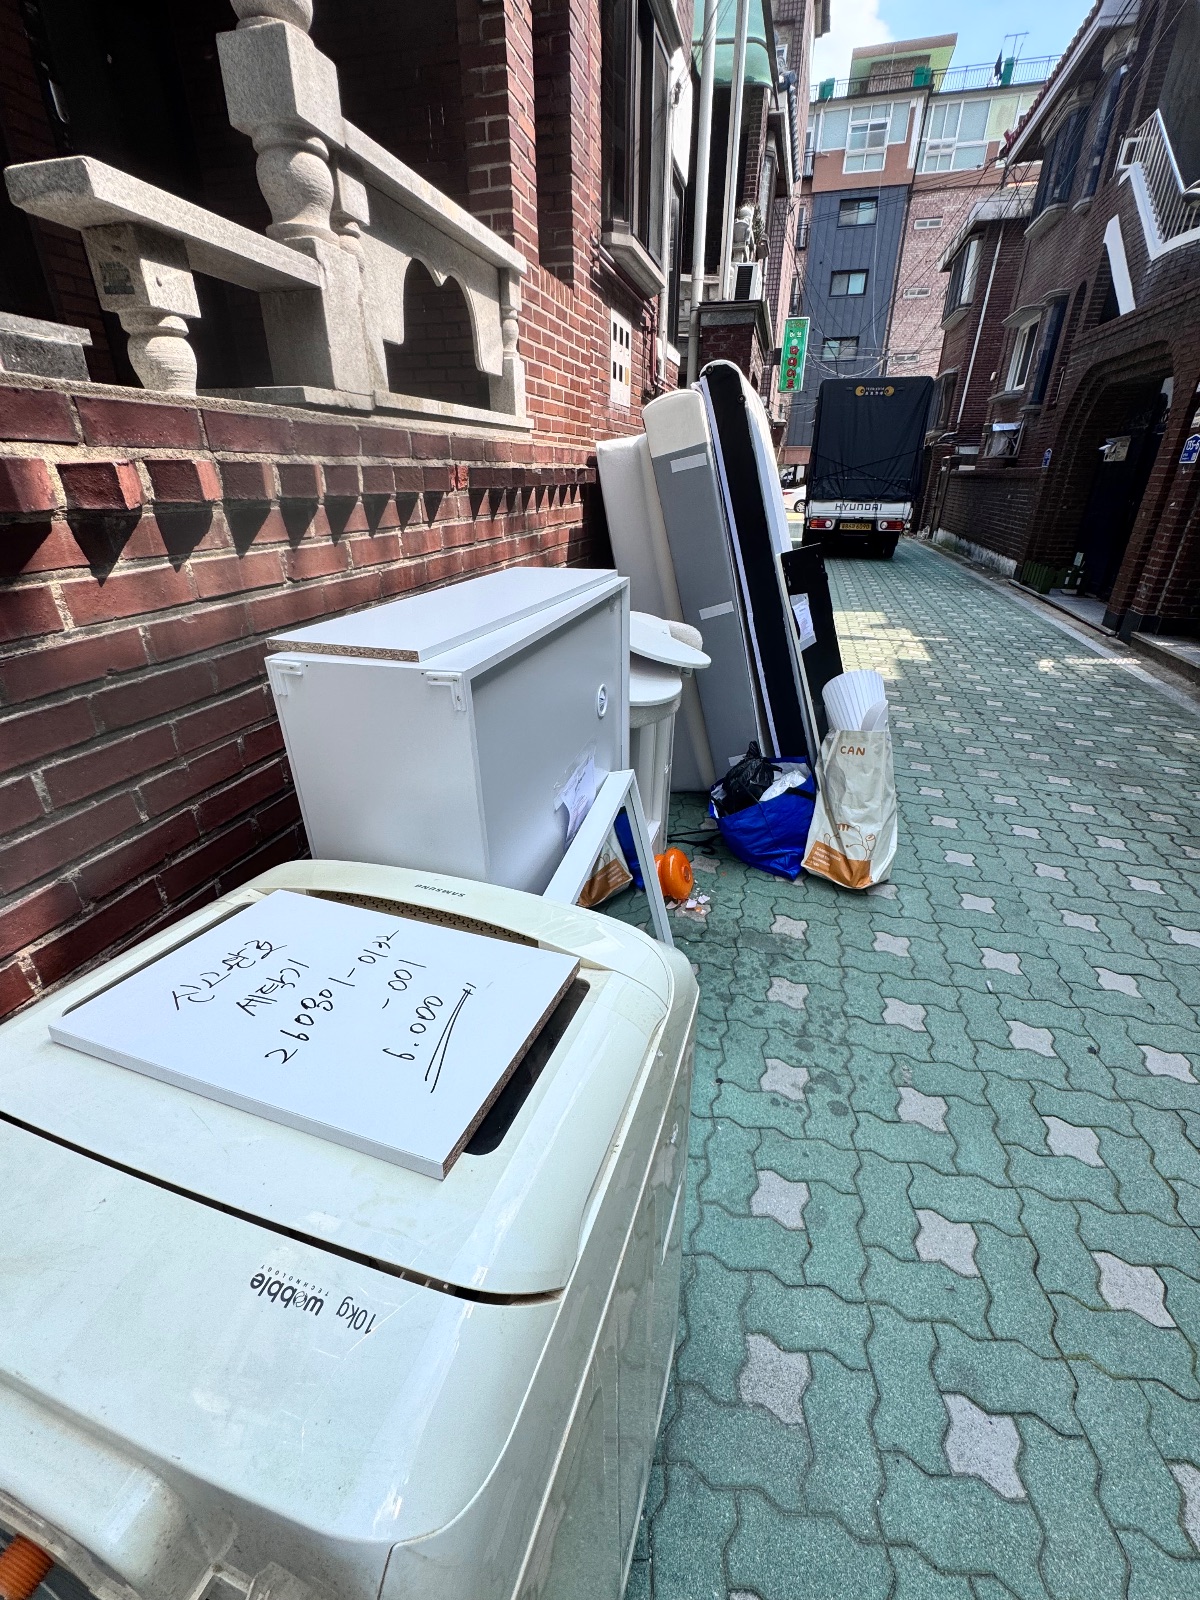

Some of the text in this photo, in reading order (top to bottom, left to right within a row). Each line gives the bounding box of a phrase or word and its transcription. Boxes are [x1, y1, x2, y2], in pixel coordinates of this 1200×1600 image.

[835, 503, 882, 511] HYUNDAI
[840, 745, 866, 756] CAN
[414, 884, 466, 897] SAMSUNG
[236, 959, 309, 1016] 세탁기
[260, 1264, 329, 1297] TECHNOLOGY
[250, 1273, 376, 1334] 10kg wobble
